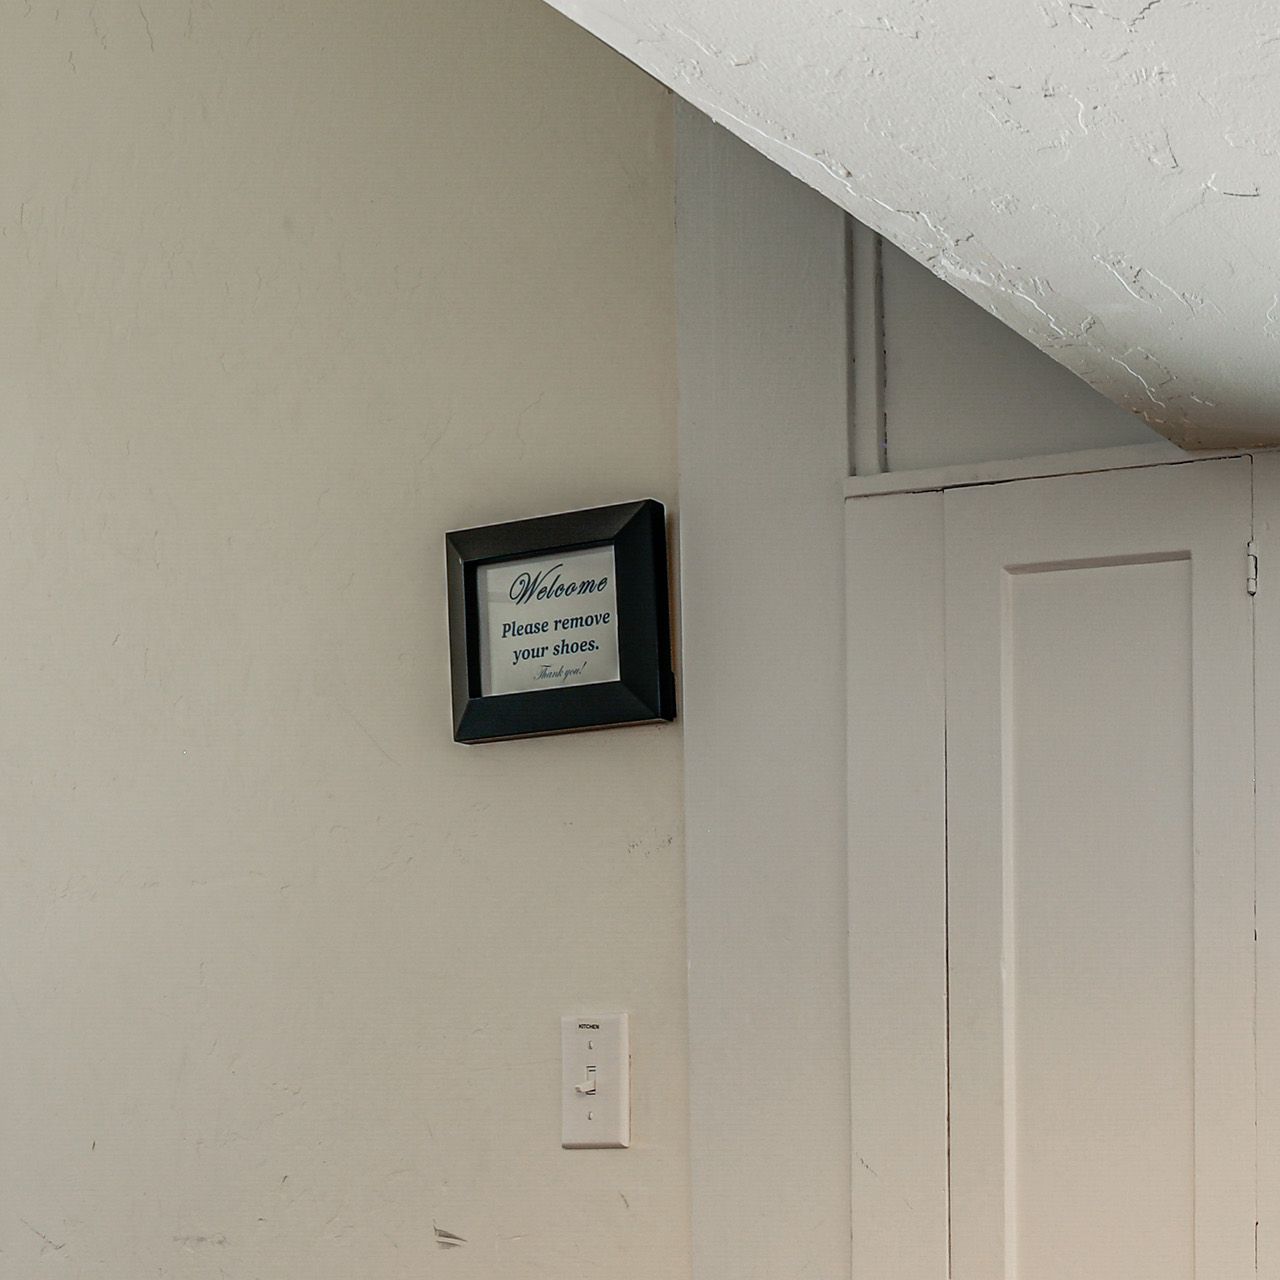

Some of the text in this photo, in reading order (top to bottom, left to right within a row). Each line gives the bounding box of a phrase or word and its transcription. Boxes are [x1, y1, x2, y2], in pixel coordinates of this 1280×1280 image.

[509, 563, 608, 605] Welcome
[502, 612, 610, 638] Please remove
[513, 639, 599, 665] your shoes.
[533, 661, 587, 681] Thank you!
